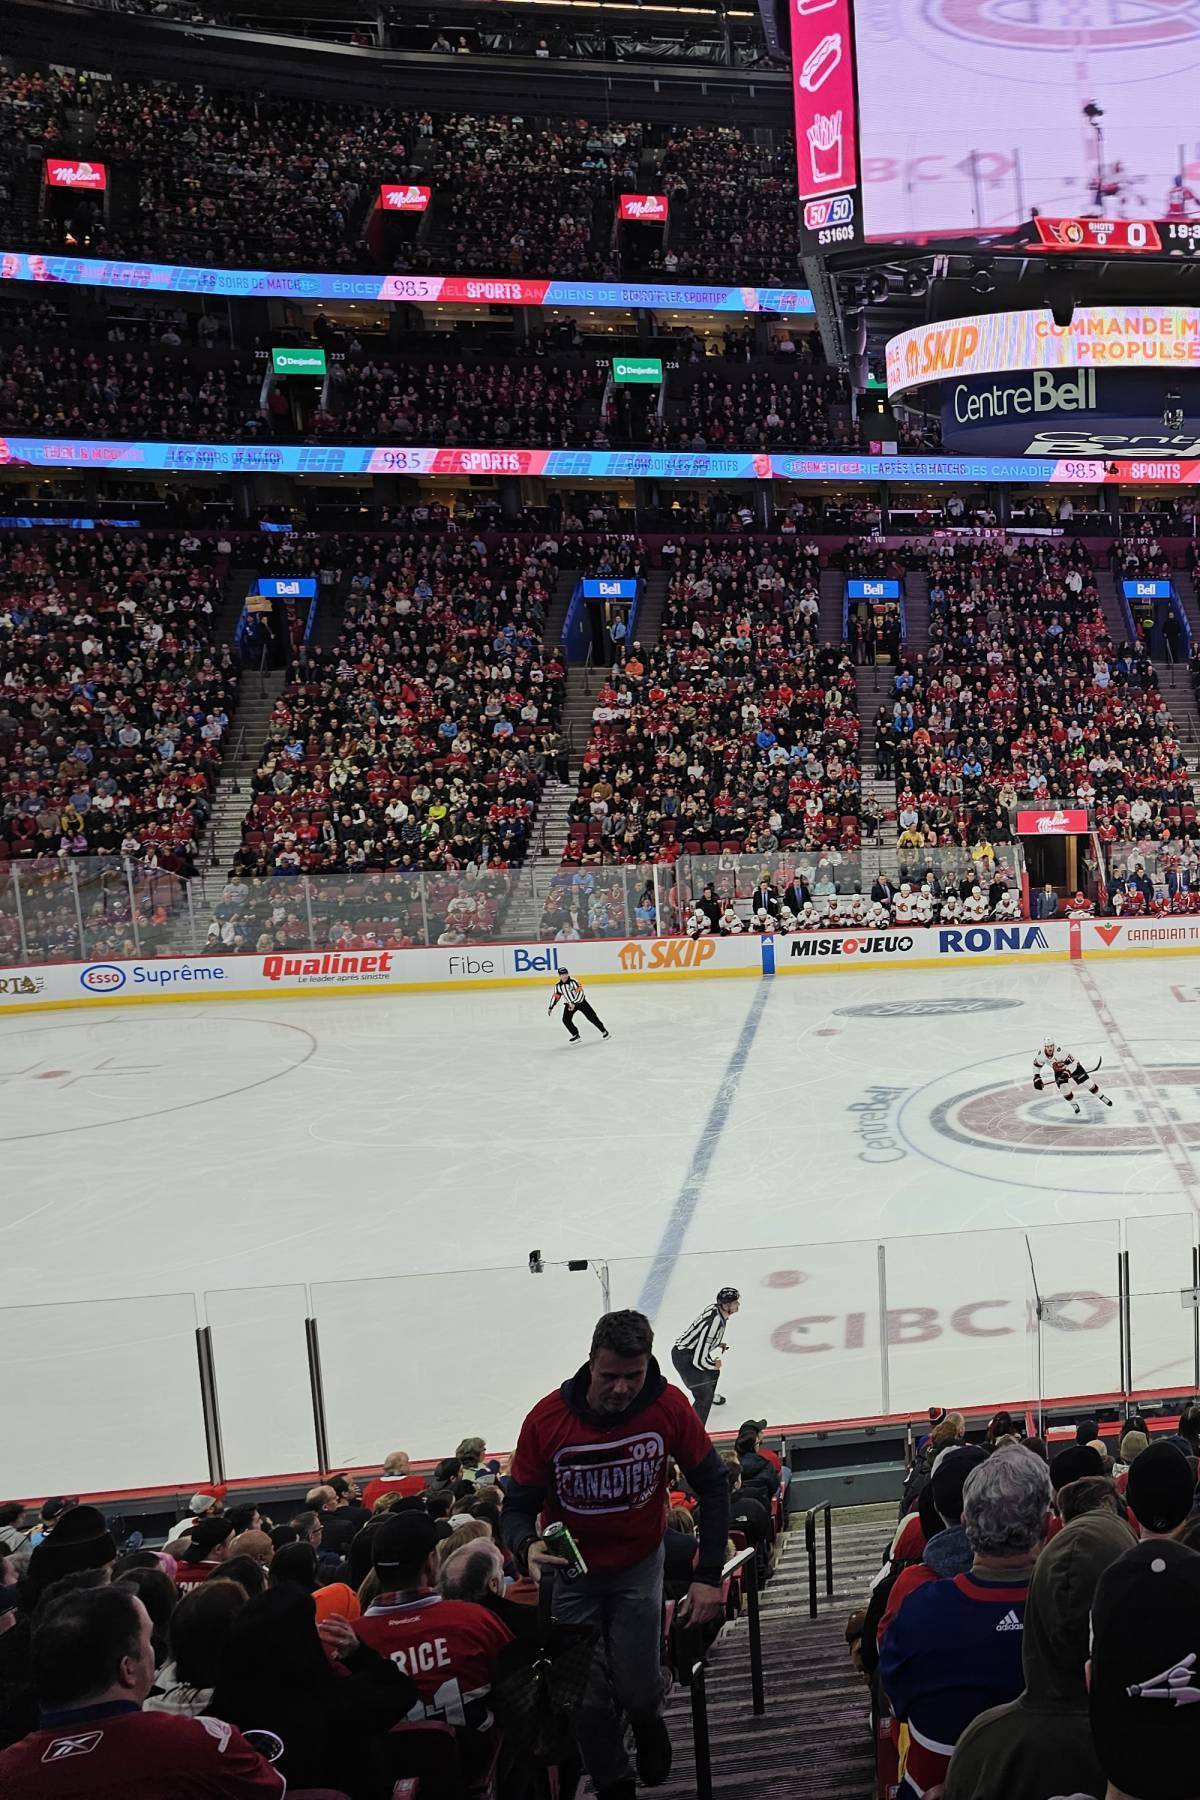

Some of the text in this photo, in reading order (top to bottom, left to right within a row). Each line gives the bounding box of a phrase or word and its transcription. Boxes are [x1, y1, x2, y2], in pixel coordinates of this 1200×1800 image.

[53, 167, 101, 185] Molson
[386, 191, 427, 208] Molson
[626, 202, 664, 217] Molson
[808, 198, 850, 224] 50/50
[818, 226, 855, 244] 53160$
[1127, 223, 1146, 247] 0
[1187, 239, 1196, 249] 1
[219, 276, 250, 290] SOIRS
[266, 278, 301, 290] MATCH
[466, 282, 522, 299] SPORTS
[922, 326, 979, 374] SKIP
[287, 359, 322, 369] Desjardins
[626, 366, 659, 376] Desjardins
[296, 449, 346, 471] IGA
[460, 452, 521, 471] SPORTS
[543, 452, 592, 475] IGA
[1131, 463, 1181, 480] SPORTS
[276, 582, 300, 595] Bell
[600, 582, 621, 595] Bell
[863, 583, 884, 595] Bell
[1137, 583, 1156, 595] Bell
[1036, 817, 1070, 829] Molson
[939, 926, 1049, 954] RONA
[1127, 927, 1186, 941] CANADIAN
[448, 947, 560, 975] Fibe Bell
[647, 939, 716, 970] SKIP
[262, 952, 394, 981] Qualinet
[87, 972, 120, 984] Esso
[298, 976, 308, 984] Le
[310, 975, 336, 984] leader
[361, 972, 390, 982] sinistre
[871, 1000, 988, 1016] Ford
[769, 1298, 1017, 1355] CIBC
[388, 1616, 421, 1625] Reebok
[995, 1622, 1025, 1632] adidas
